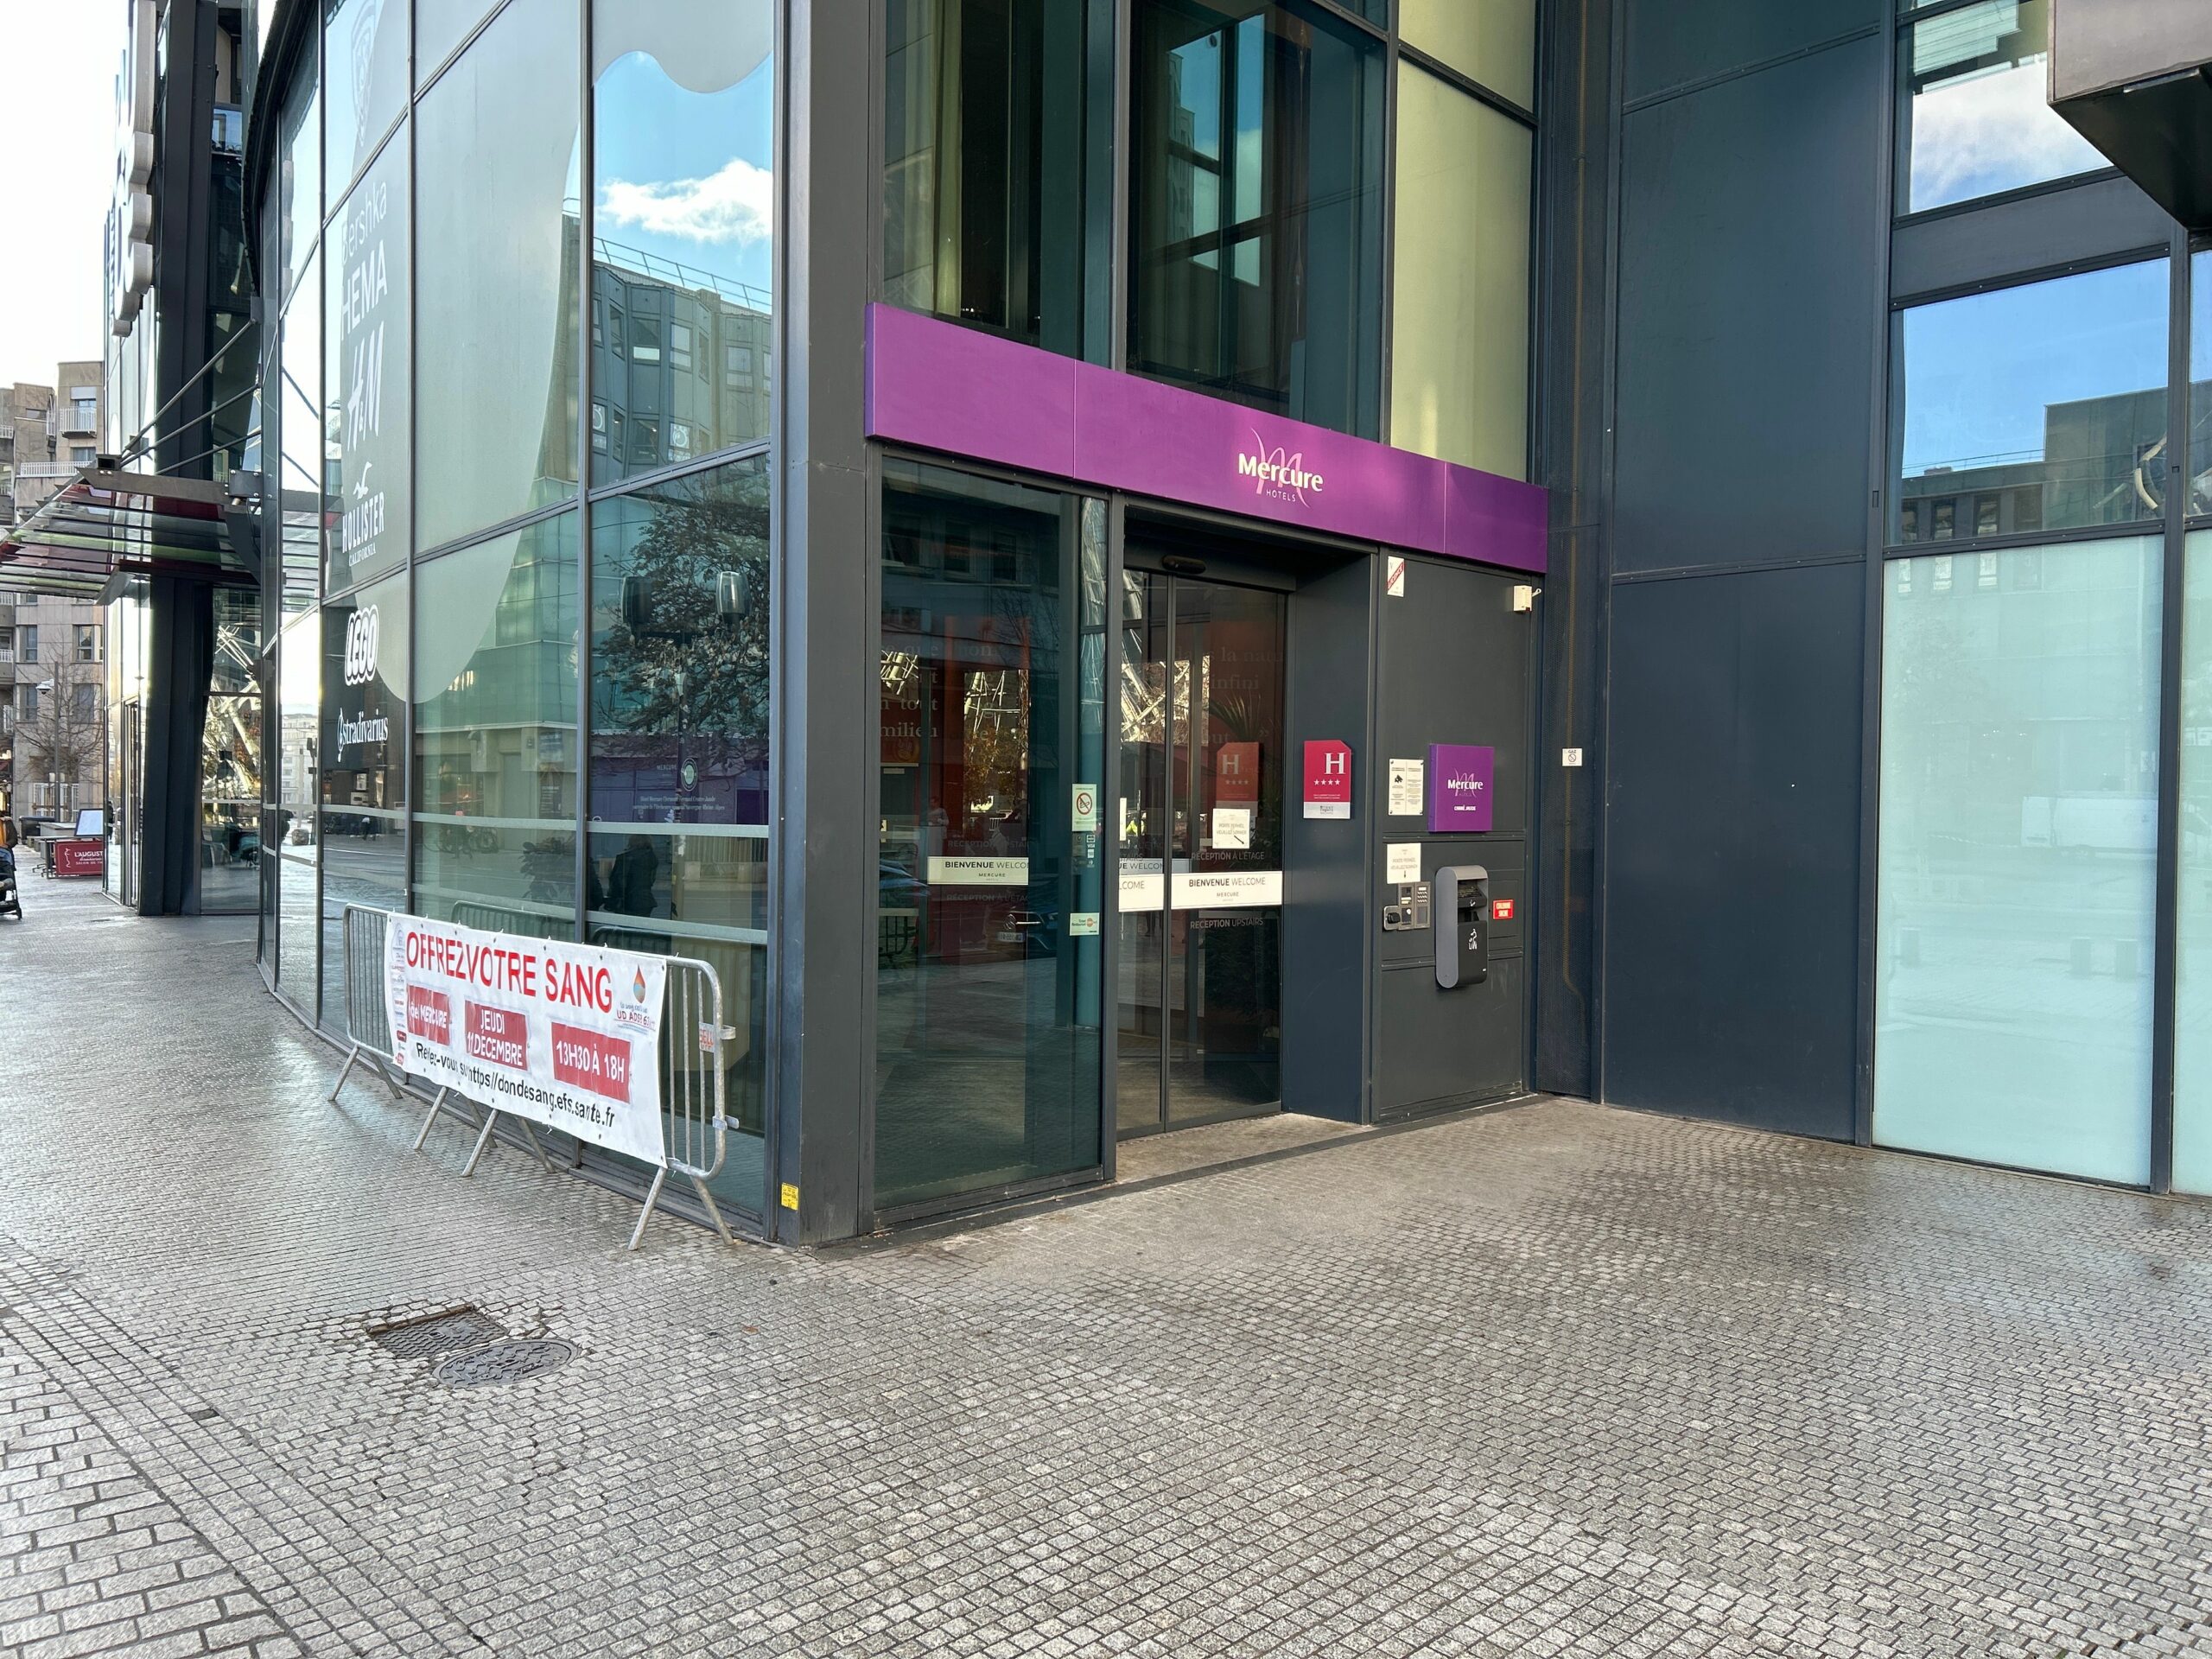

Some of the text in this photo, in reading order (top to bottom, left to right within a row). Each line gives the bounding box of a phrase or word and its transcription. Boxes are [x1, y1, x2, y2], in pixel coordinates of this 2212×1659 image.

[341, 239, 387, 340] HEMA
[347, 321, 385, 452] H&M
[1238, 453, 1324, 492] Mercure
[1266, 489, 1296, 502] HOTELS
[342, 491, 385, 553] HOLLISTER
[349, 542, 377, 567] CALIFORNIA
[346, 608, 378, 682] LEGO
[1324, 752, 1346, 775] H
[1447, 779, 1484, 790] Mercure
[1119, 880, 1145, 890] LCOME
[1189, 877, 1266, 887] BIENVENUE WELCOME
[1191, 918, 1263, 929] RECEPTION UPSTAIRS
[545, 957, 613, 1014] SANG
[480, 1009, 505, 1035] JEUDI
[474, 1030, 523, 1066] DÉCEMBRE
[556, 1040, 625, 1083] 13H30 À 18H
